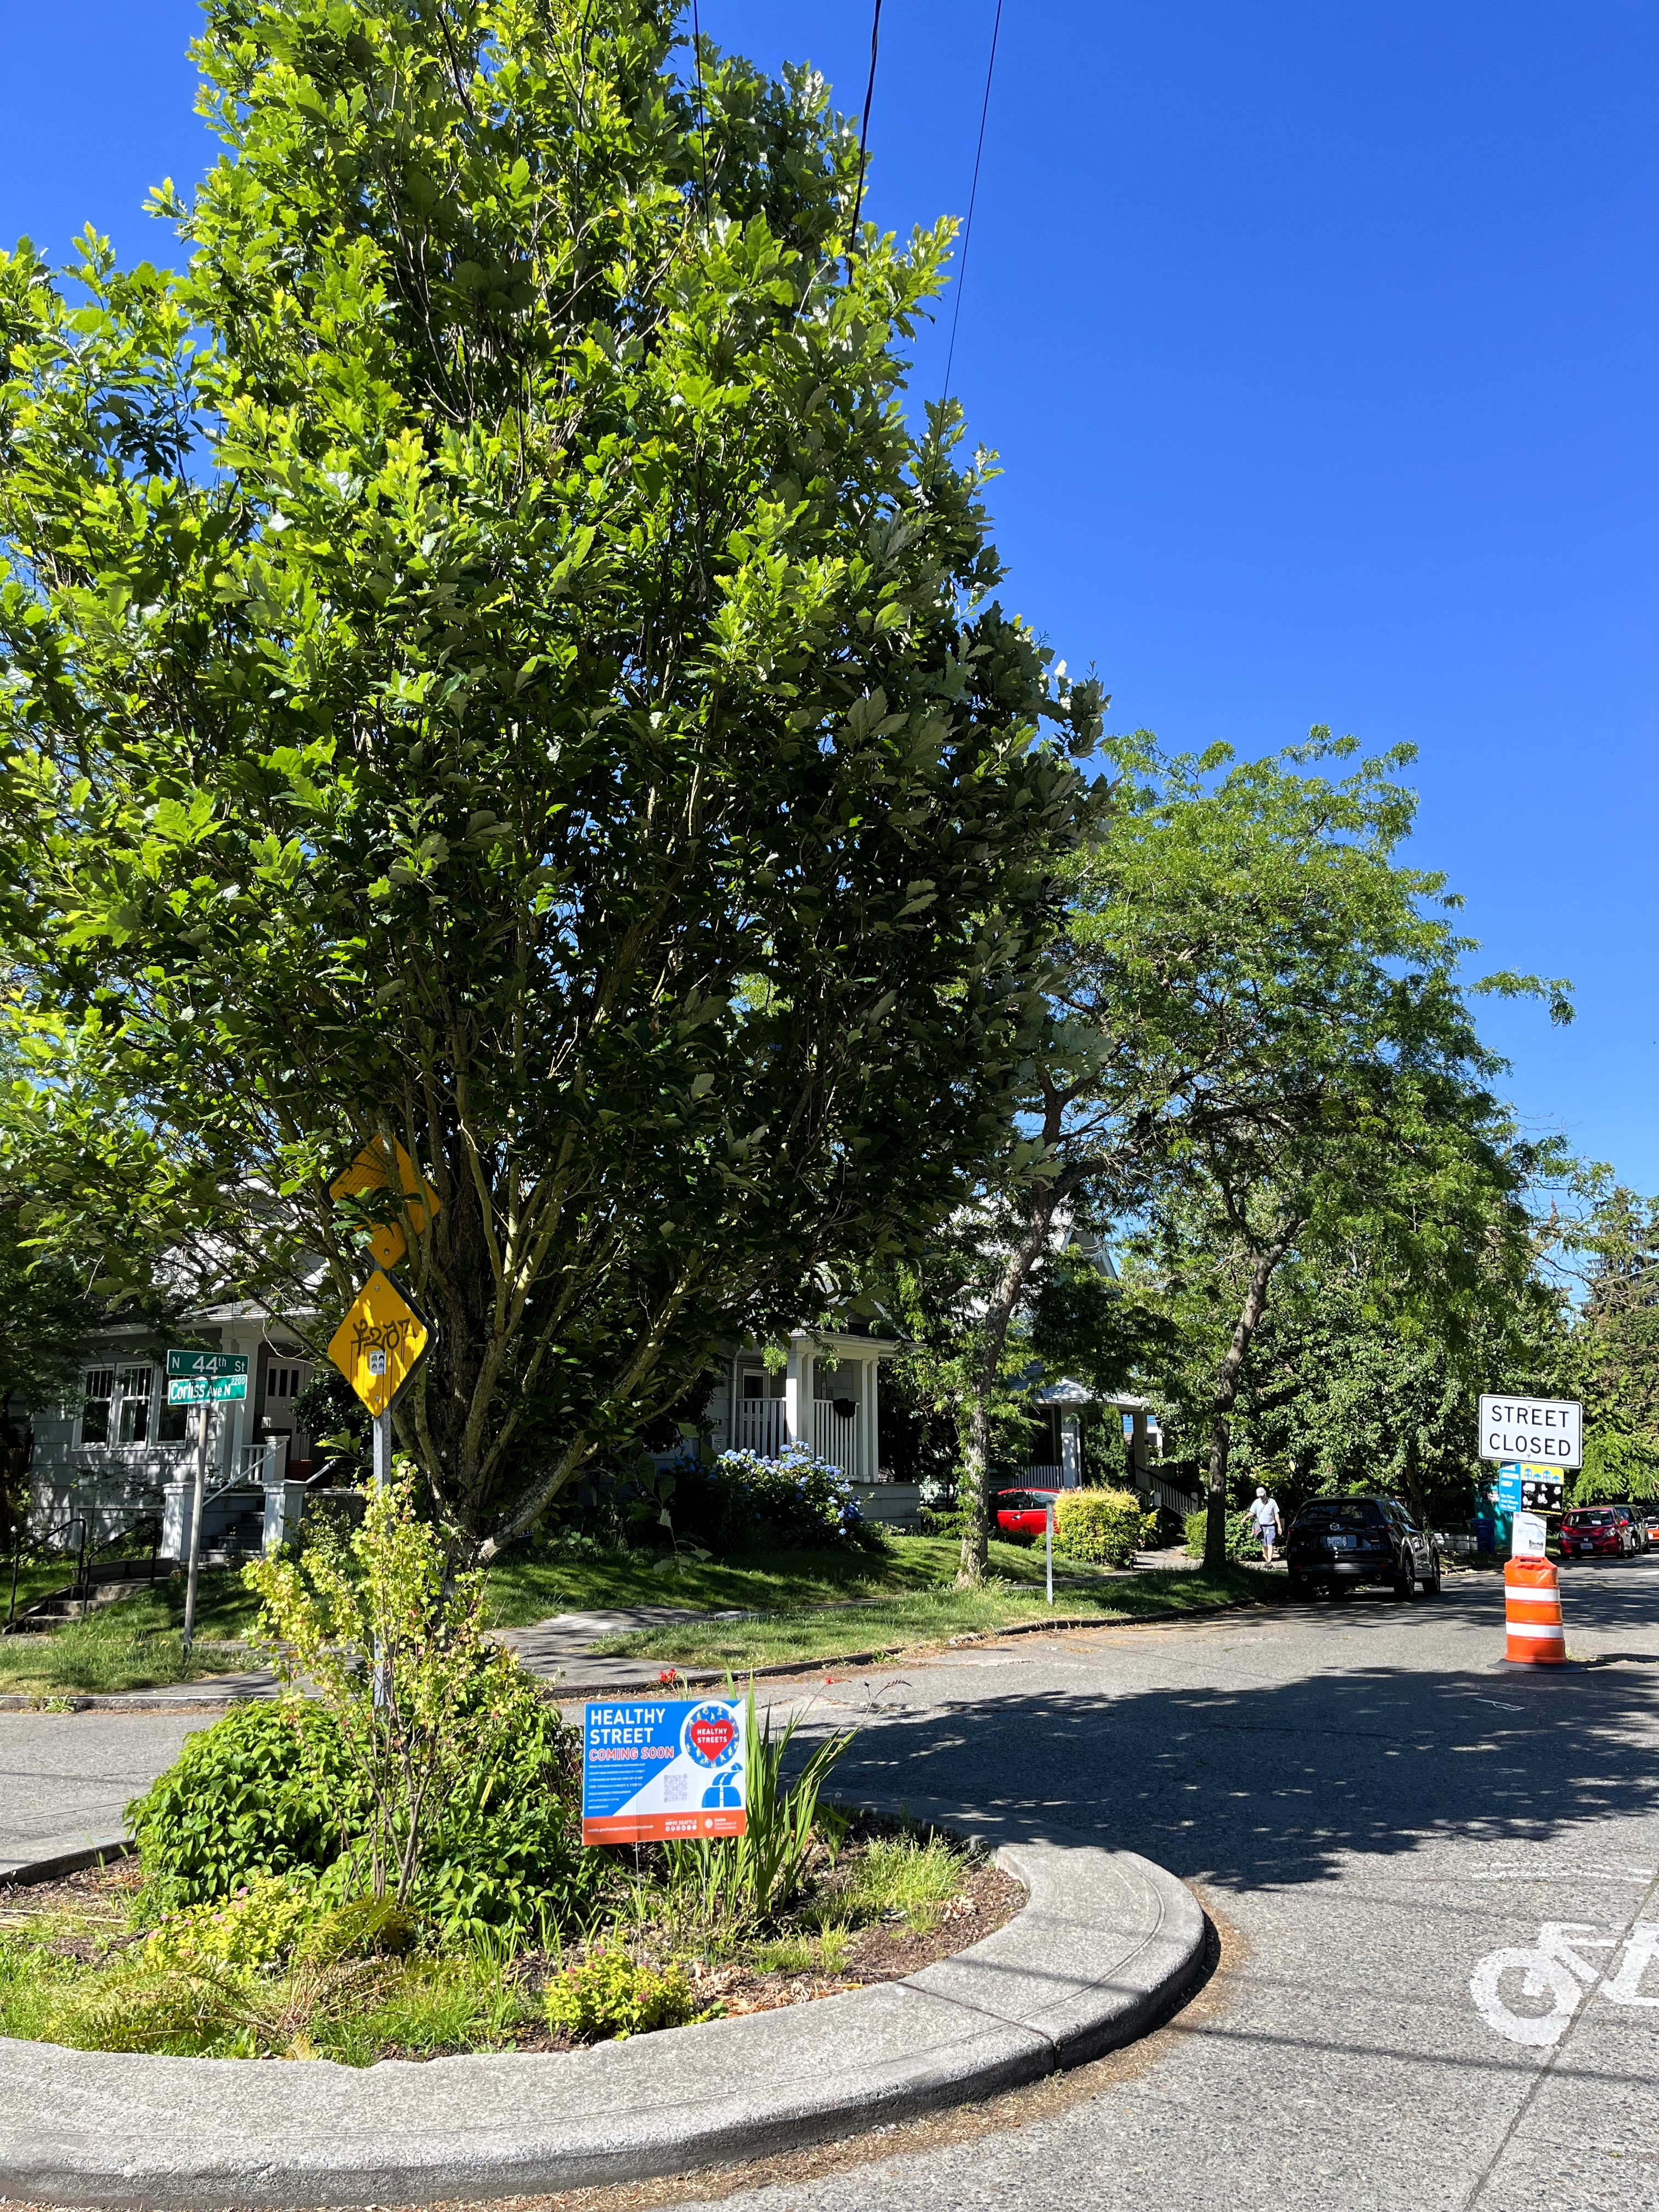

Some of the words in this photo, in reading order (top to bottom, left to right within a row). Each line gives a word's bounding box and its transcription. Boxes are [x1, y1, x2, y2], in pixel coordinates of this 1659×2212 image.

[172, 1356, 180, 1369] N
[192, 1356, 227, 1374] 44th
[234, 1361, 245, 1373] St
[231, 1377, 245, 1386] 2200
[171, 1381, 205, 1400] Corliss
[207, 1385, 222, 1397] Ave
[224, 1384, 230, 1396] N
[1491, 1405, 1570, 1427] STREET
[1489, 1433, 1571, 1457] CLOSED
[591, 1708, 665, 1725] HEALTHY
[590, 1728, 653, 1745] STREET
[589, 1747, 638, 1762] COMING
[641, 1746, 674, 1759] SOON
